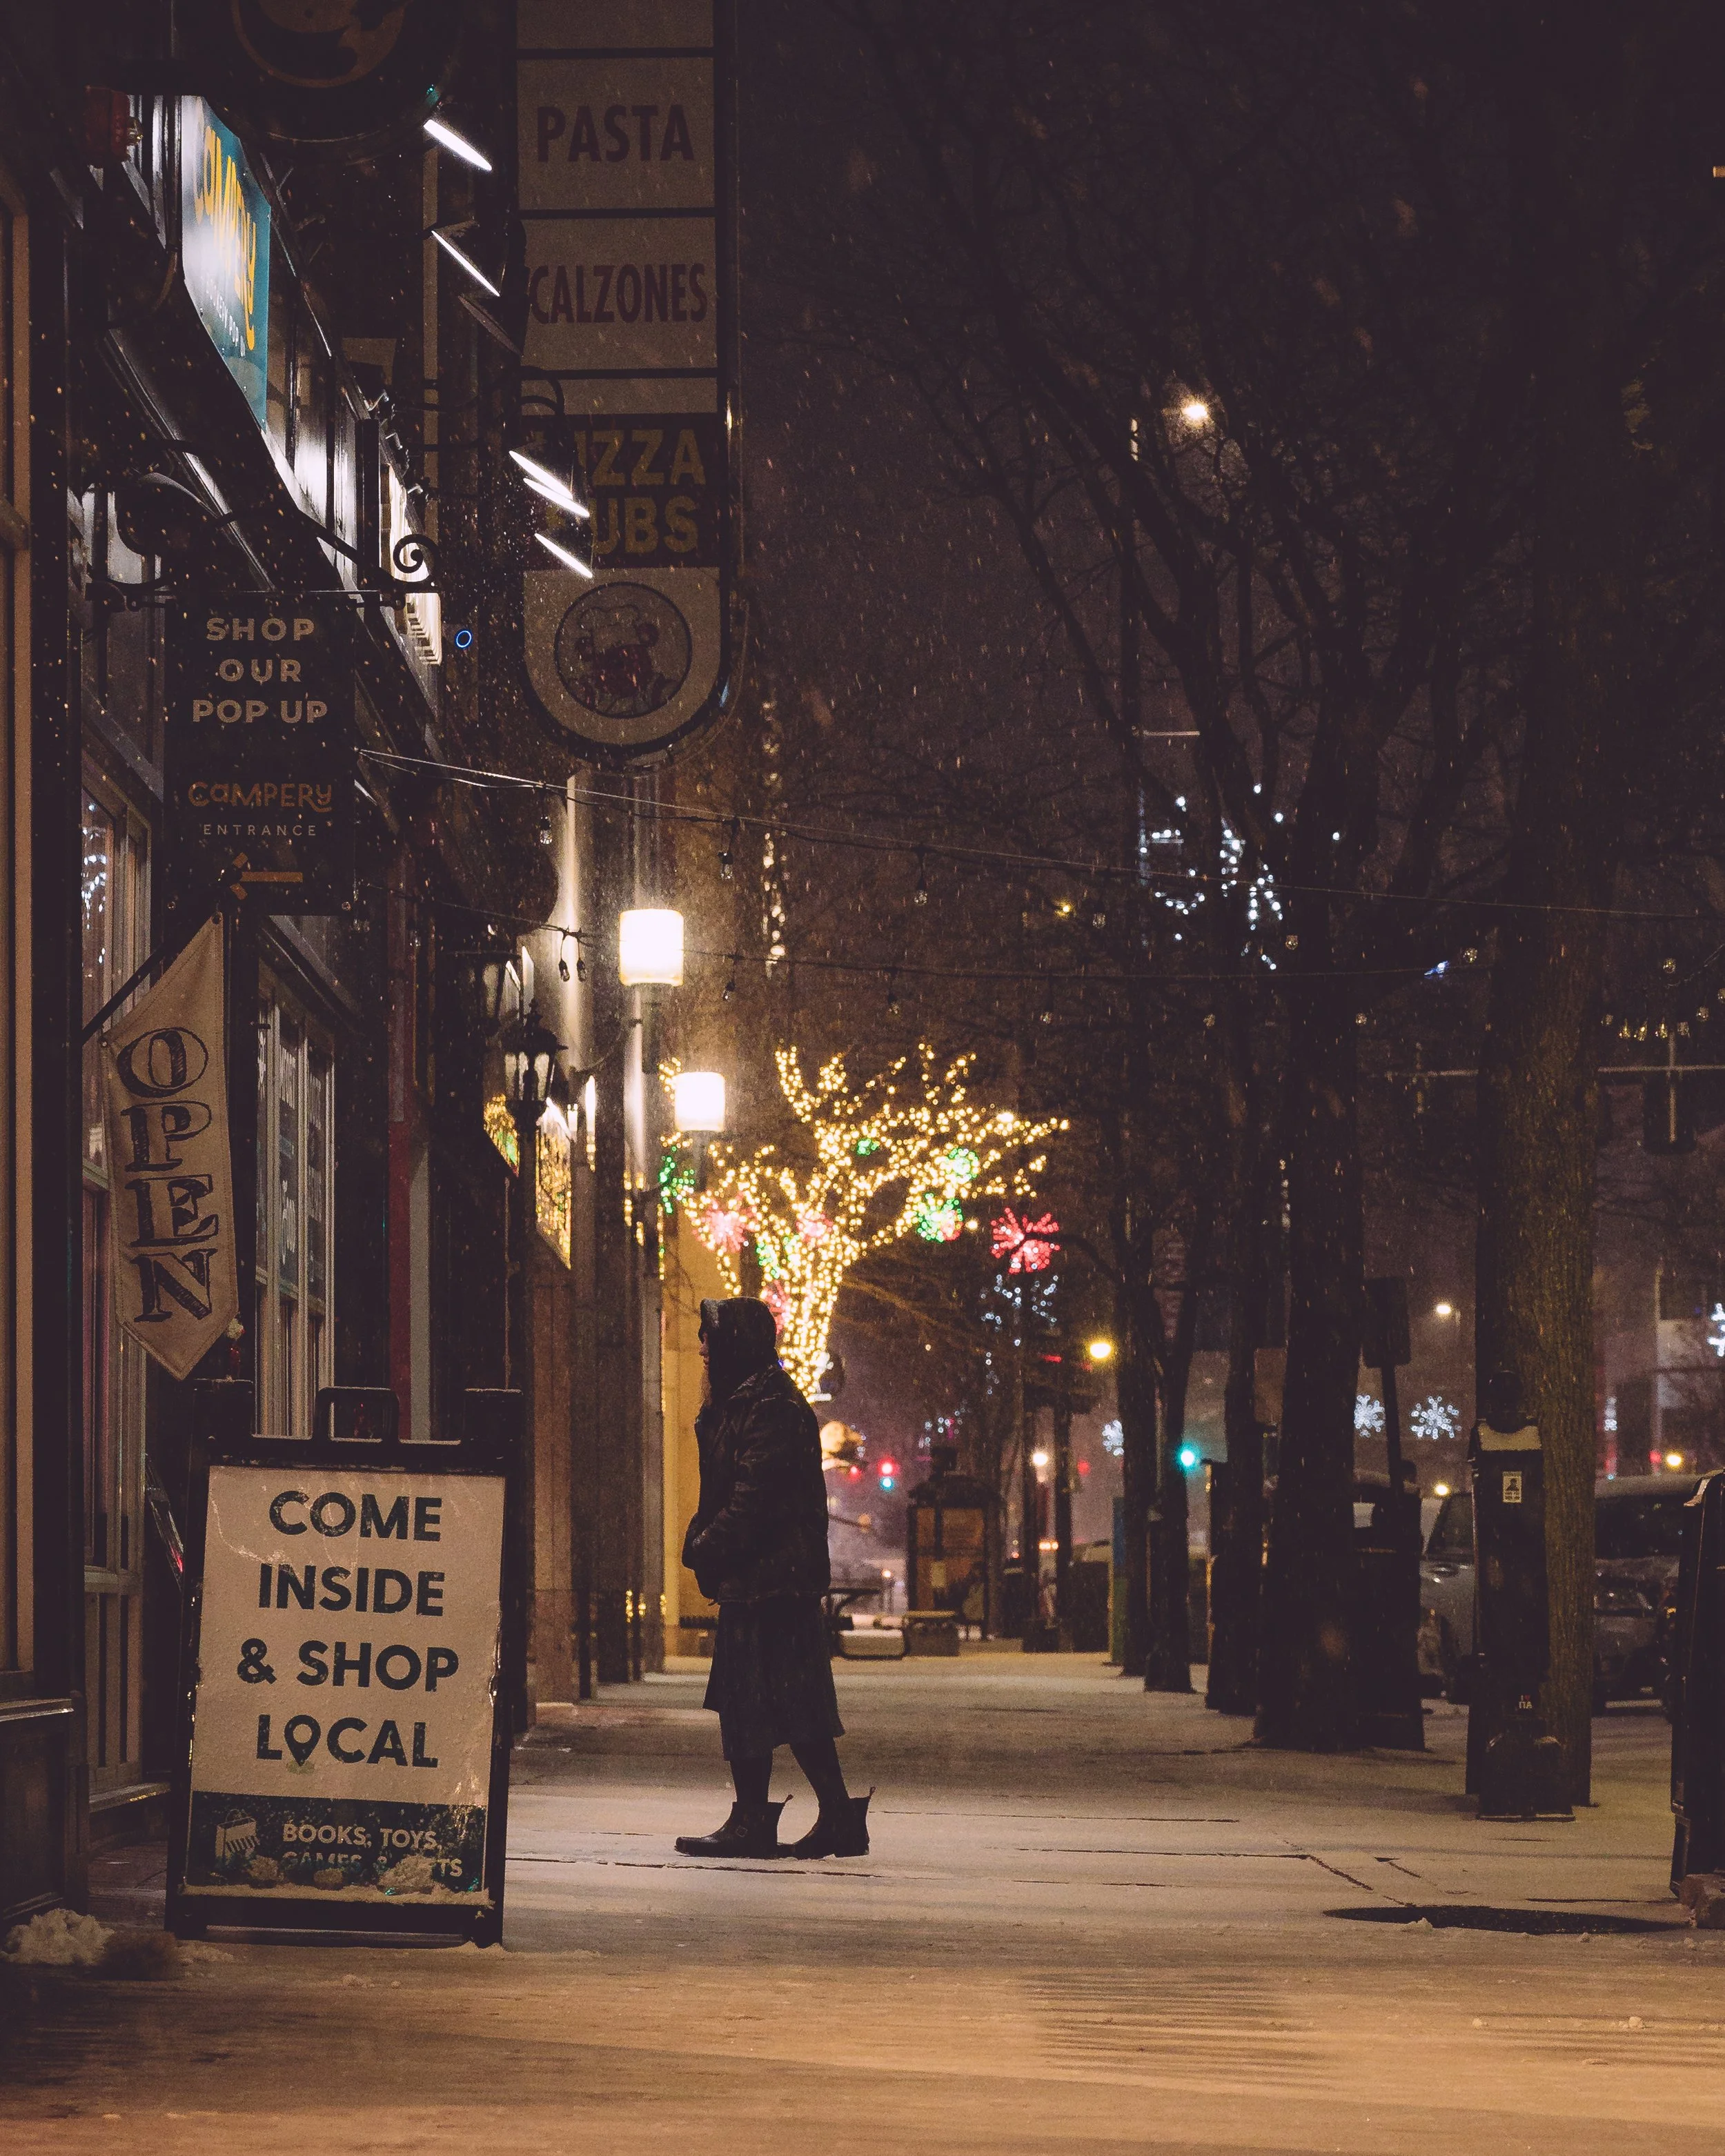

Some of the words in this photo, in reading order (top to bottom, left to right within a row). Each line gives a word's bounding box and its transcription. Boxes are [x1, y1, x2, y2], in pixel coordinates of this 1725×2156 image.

[537, 105, 695, 163] PASTA
[529, 263, 707, 324] CALZONES
[533, 429, 707, 486] IZZA
[206, 617, 315, 641] SHOP
[219, 658, 302, 682] OUR
[193, 699, 268, 723] POP
[280, 700, 328, 723] UP
[204, 824, 317, 836] ENTRANCE
[117, 1027, 219, 1323] OPEN
[269, 1490, 442, 1543] COME
[258, 1562, 445, 1617] INSIDE
[237, 1638, 277, 1685] &
[296, 1639, 459, 1692] SHOP
[256, 1714, 438, 1768] LOCAL
[282, 1823, 373, 1848] BOOKS,
